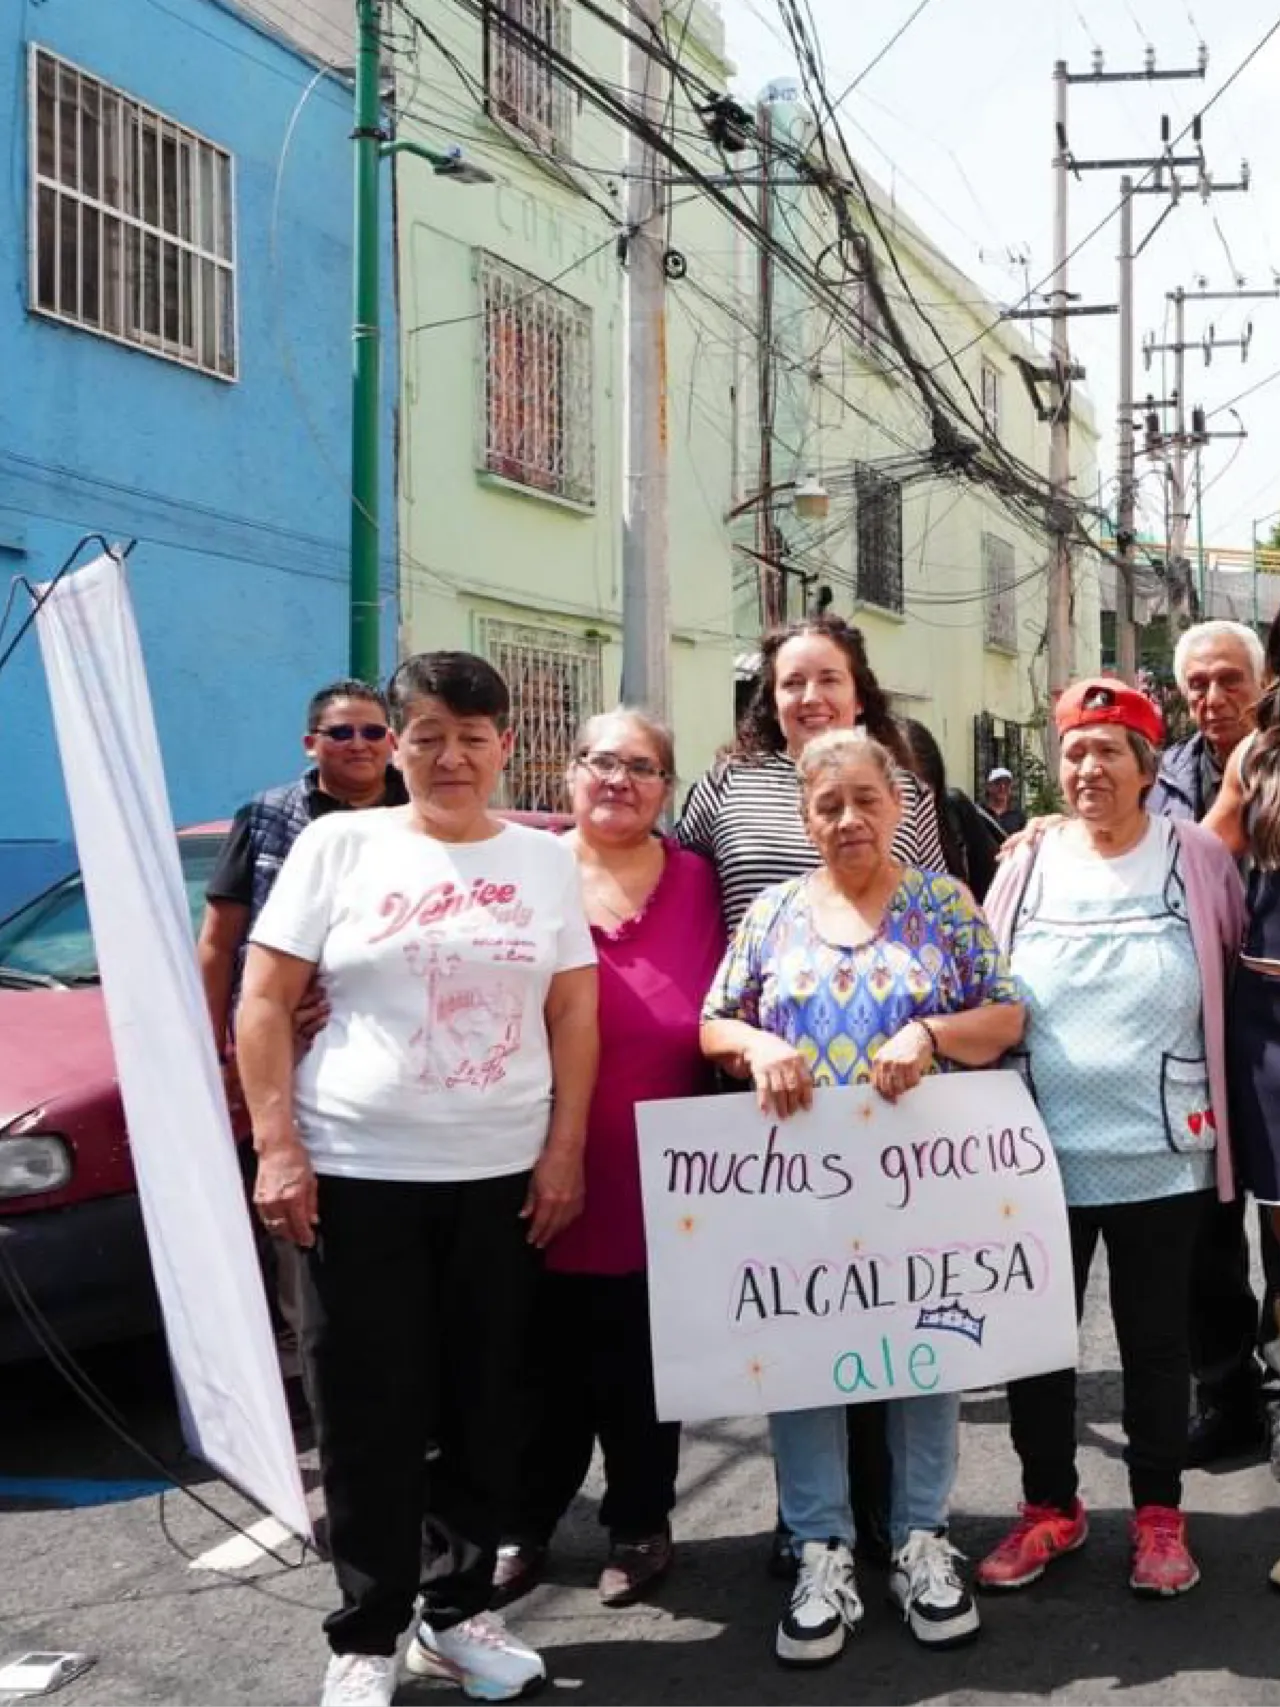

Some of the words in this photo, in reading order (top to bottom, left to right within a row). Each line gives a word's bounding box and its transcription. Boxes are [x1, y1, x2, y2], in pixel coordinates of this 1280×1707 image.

[663, 1125, 853, 1199] muchas
[880, 1126, 1046, 1209] gracias
[735, 1242, 1035, 1321] ALCALDESA
[833, 1336, 941, 1393] ale
